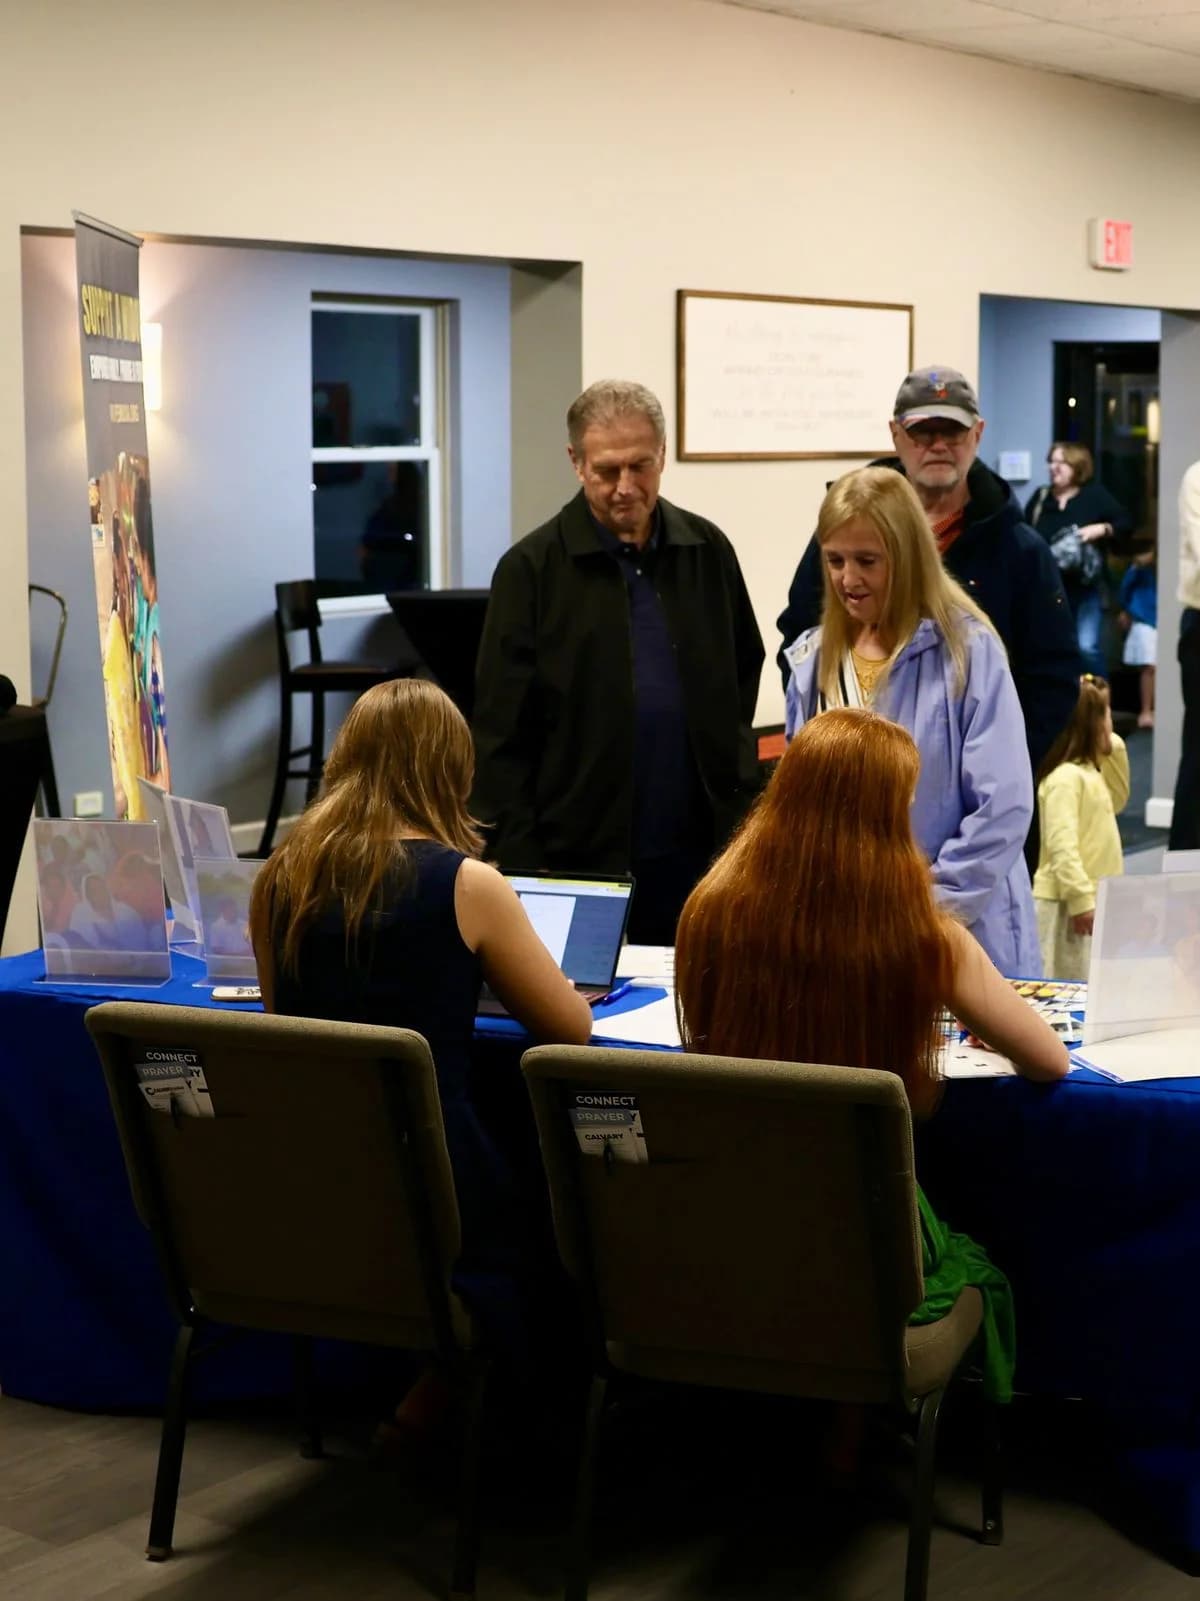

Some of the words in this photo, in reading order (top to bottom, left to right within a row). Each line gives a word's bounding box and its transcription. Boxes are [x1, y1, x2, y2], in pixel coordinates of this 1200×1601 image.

[145, 1052, 198, 1063] CONNECT
[142, 1066, 184, 1076] PRAYER
[575, 1095, 636, 1106] CONNECT
[576, 1112, 625, 1121] PRAYER
[584, 1133, 624, 1141] CALVARY
